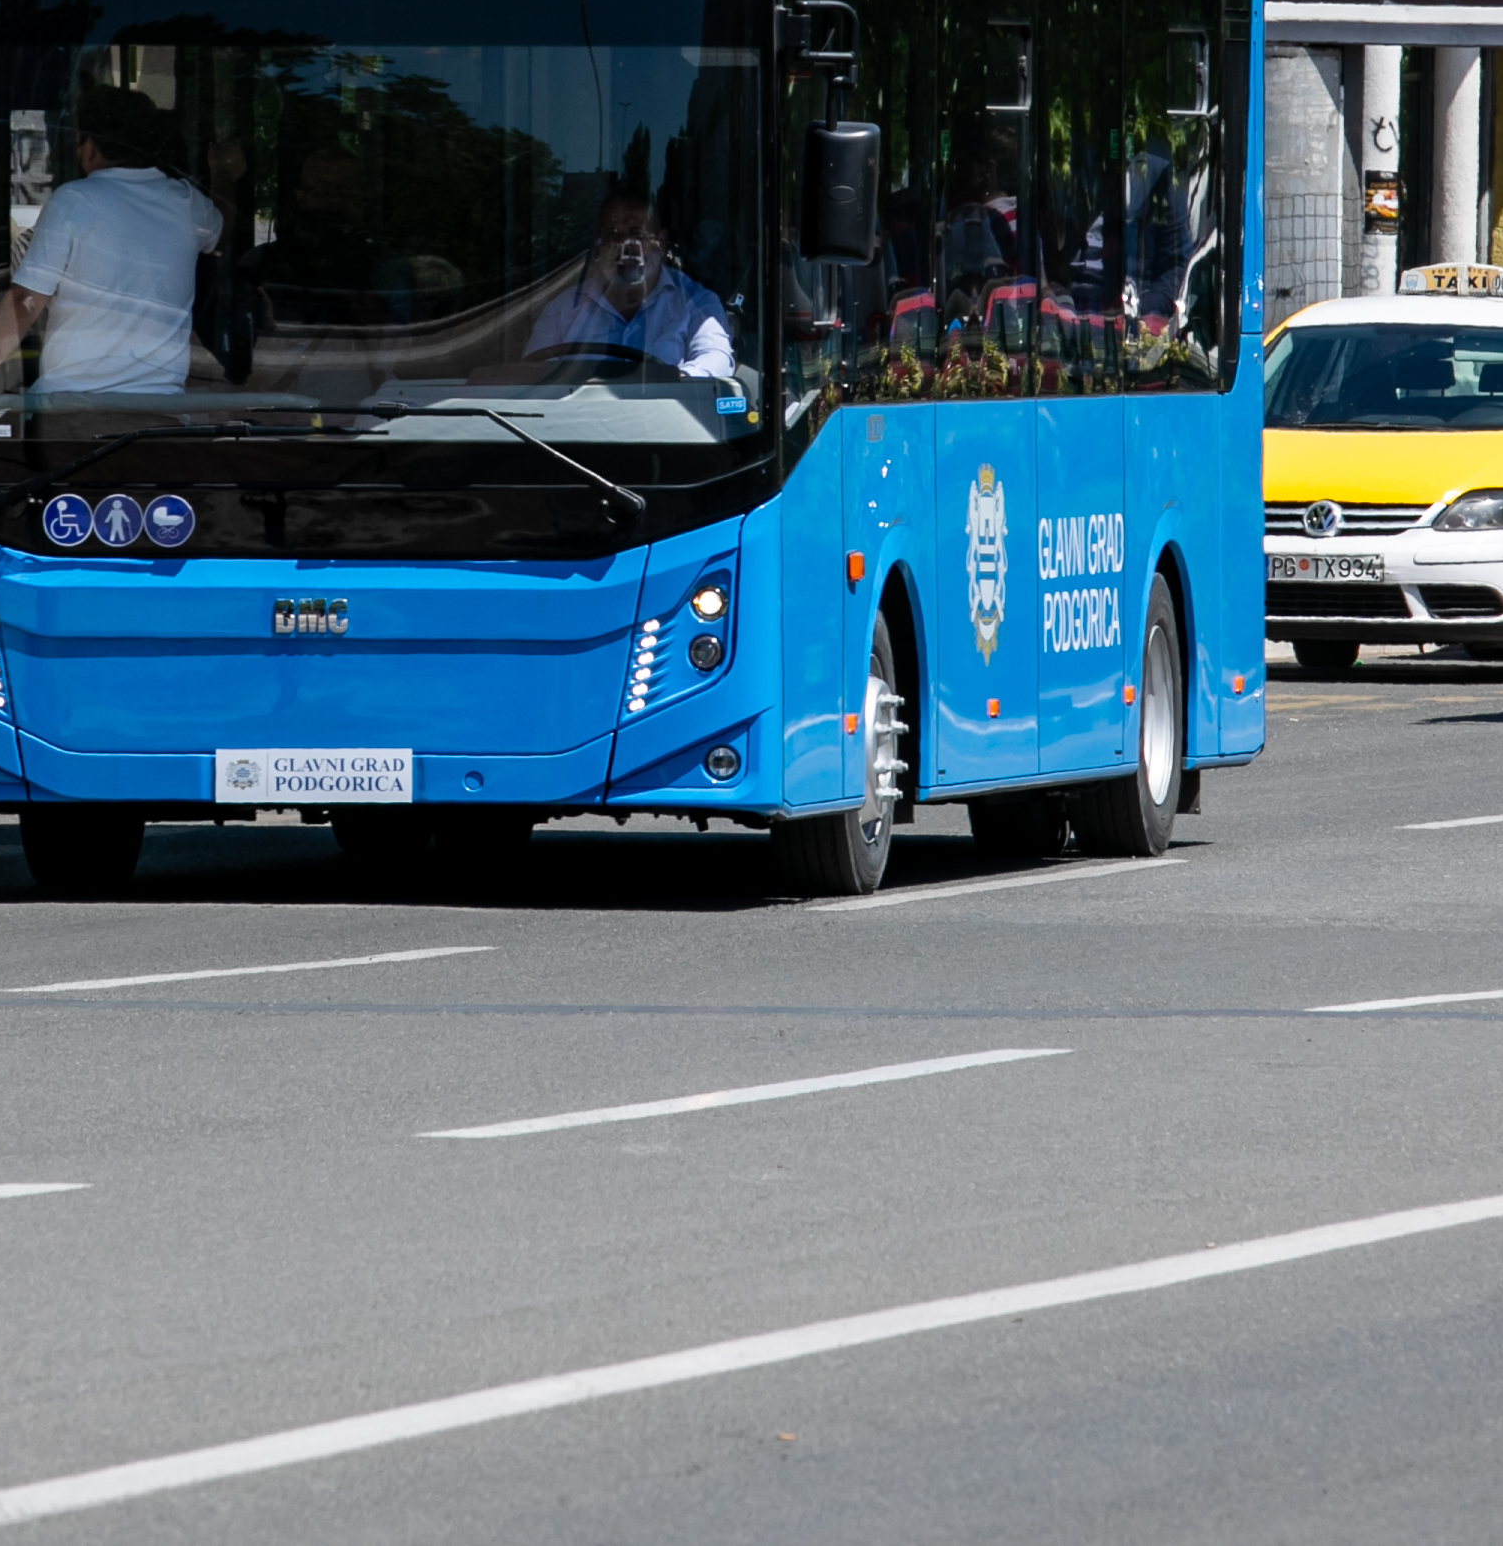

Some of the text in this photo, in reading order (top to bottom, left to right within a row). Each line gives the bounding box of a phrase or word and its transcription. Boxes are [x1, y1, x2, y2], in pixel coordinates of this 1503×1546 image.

[1433, 275, 1489, 289] TAXI
[1038, 513, 1124, 580] GLAVNI GRAD
[1271, 555, 1377, 579] PG TX934
[275, 598, 349, 634] BMC
[1043, 587, 1121, 653] PODGORICA
[274, 758, 404, 772] GLAVNI GRAD
[275, 776, 403, 792] PODGORICA
